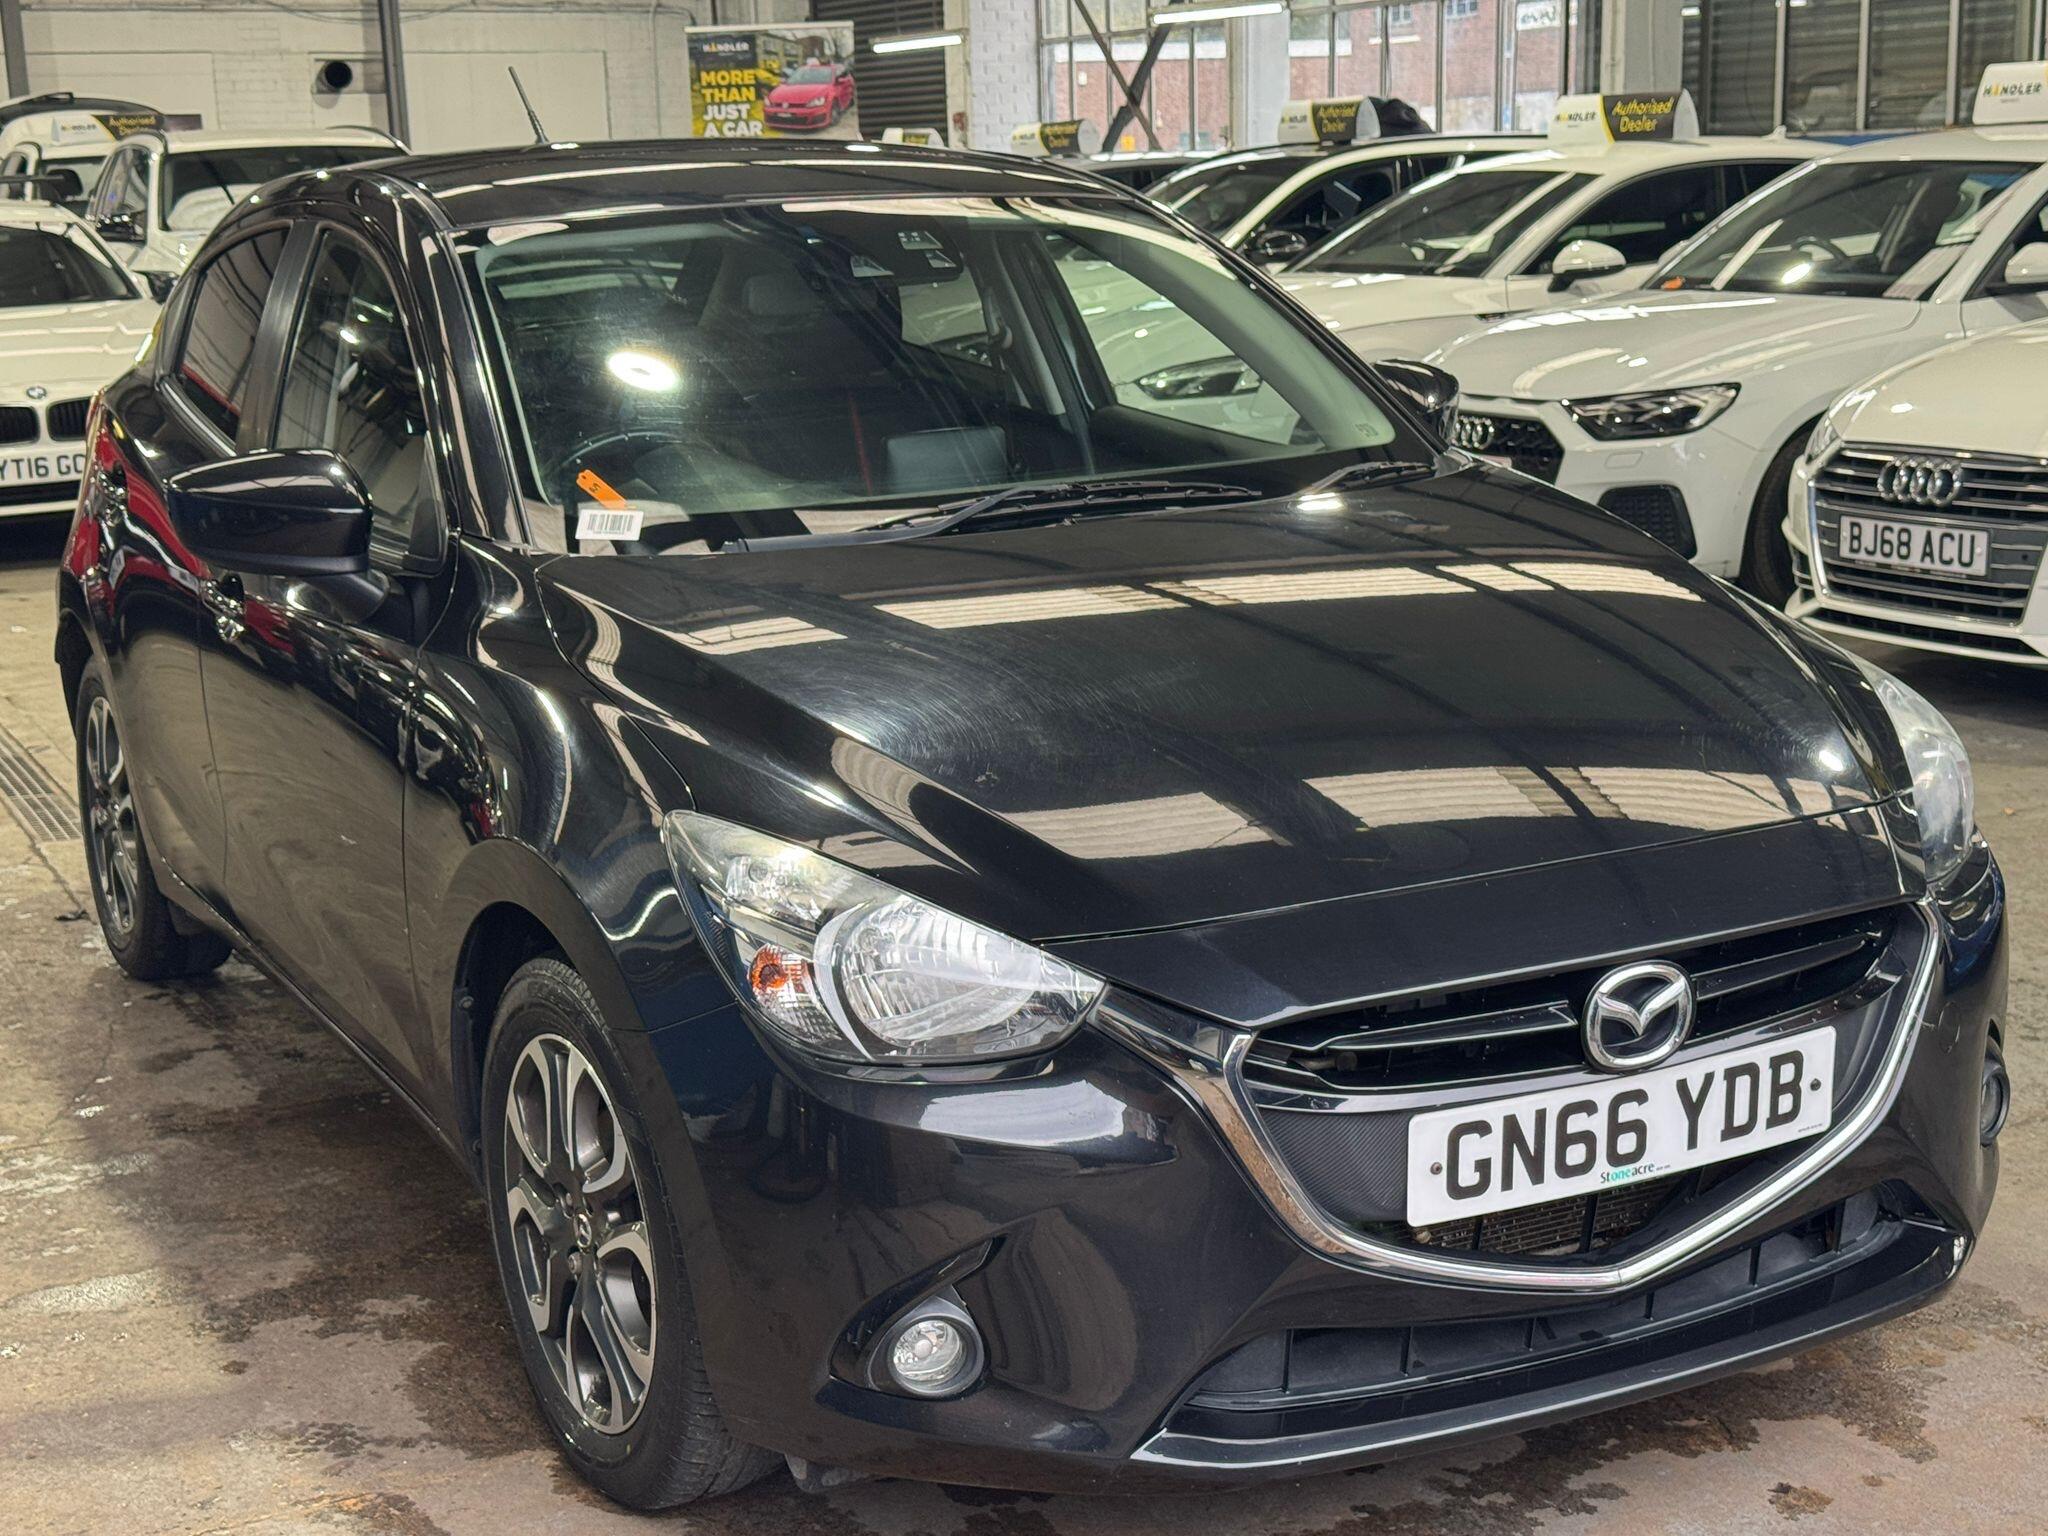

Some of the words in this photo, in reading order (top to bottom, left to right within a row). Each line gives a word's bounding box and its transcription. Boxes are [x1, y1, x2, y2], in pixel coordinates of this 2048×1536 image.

[701, 70, 756, 85] MORE
[702, 87, 755, 102] THAN
[703, 105, 750, 119] JUST
[704, 123, 720, 137] A
[722, 120, 763, 137] CAR
[1849, 522, 1911, 560] BJ68
[1920, 530, 1975, 567] ACU
[1446, 1088, 1650, 1200] GN66
[1676, 1049, 1804, 1151] YDB
[1600, 1162, 1656, 1185] Stoneacre
